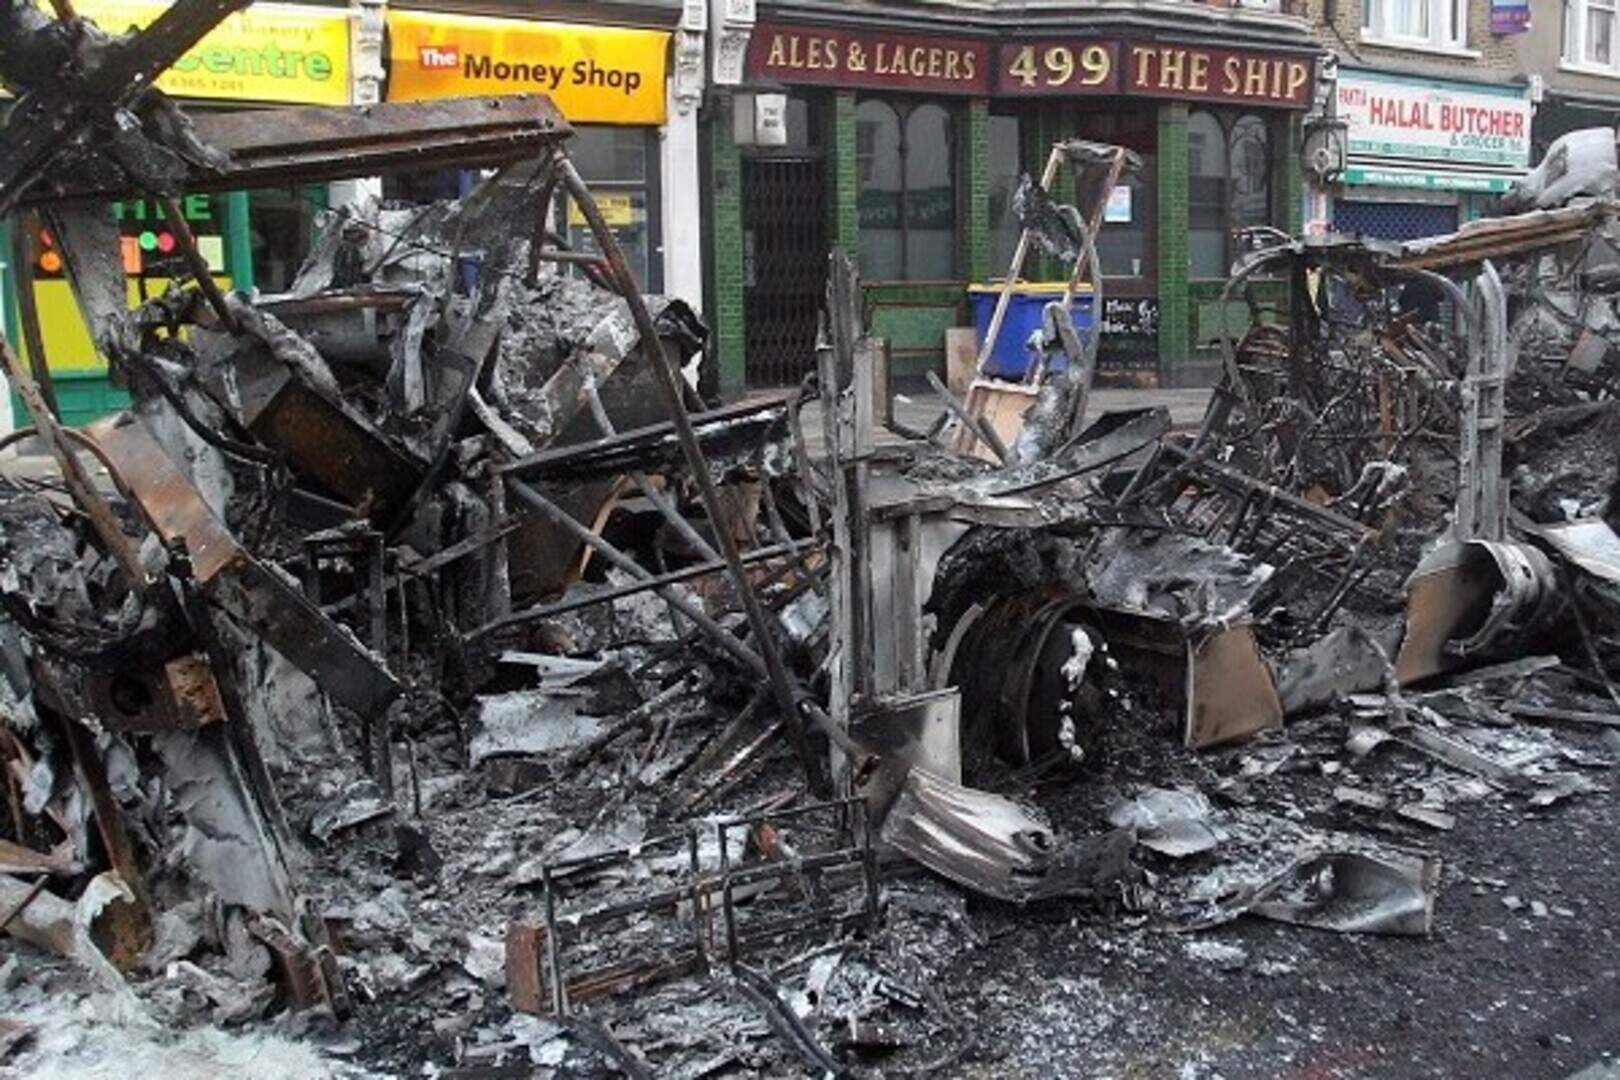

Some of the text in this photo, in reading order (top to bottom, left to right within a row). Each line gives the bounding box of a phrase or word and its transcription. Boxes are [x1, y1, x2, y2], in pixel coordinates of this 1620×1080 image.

[421, 48, 641, 94] The Money Shop
[767, 35, 976, 79] ALES & LAGERS
[1009, 45, 1111, 87] 499
[1133, 47, 1308, 99] THE SHIP
[1370, 97, 1524, 138] HALAL BUTCHER
